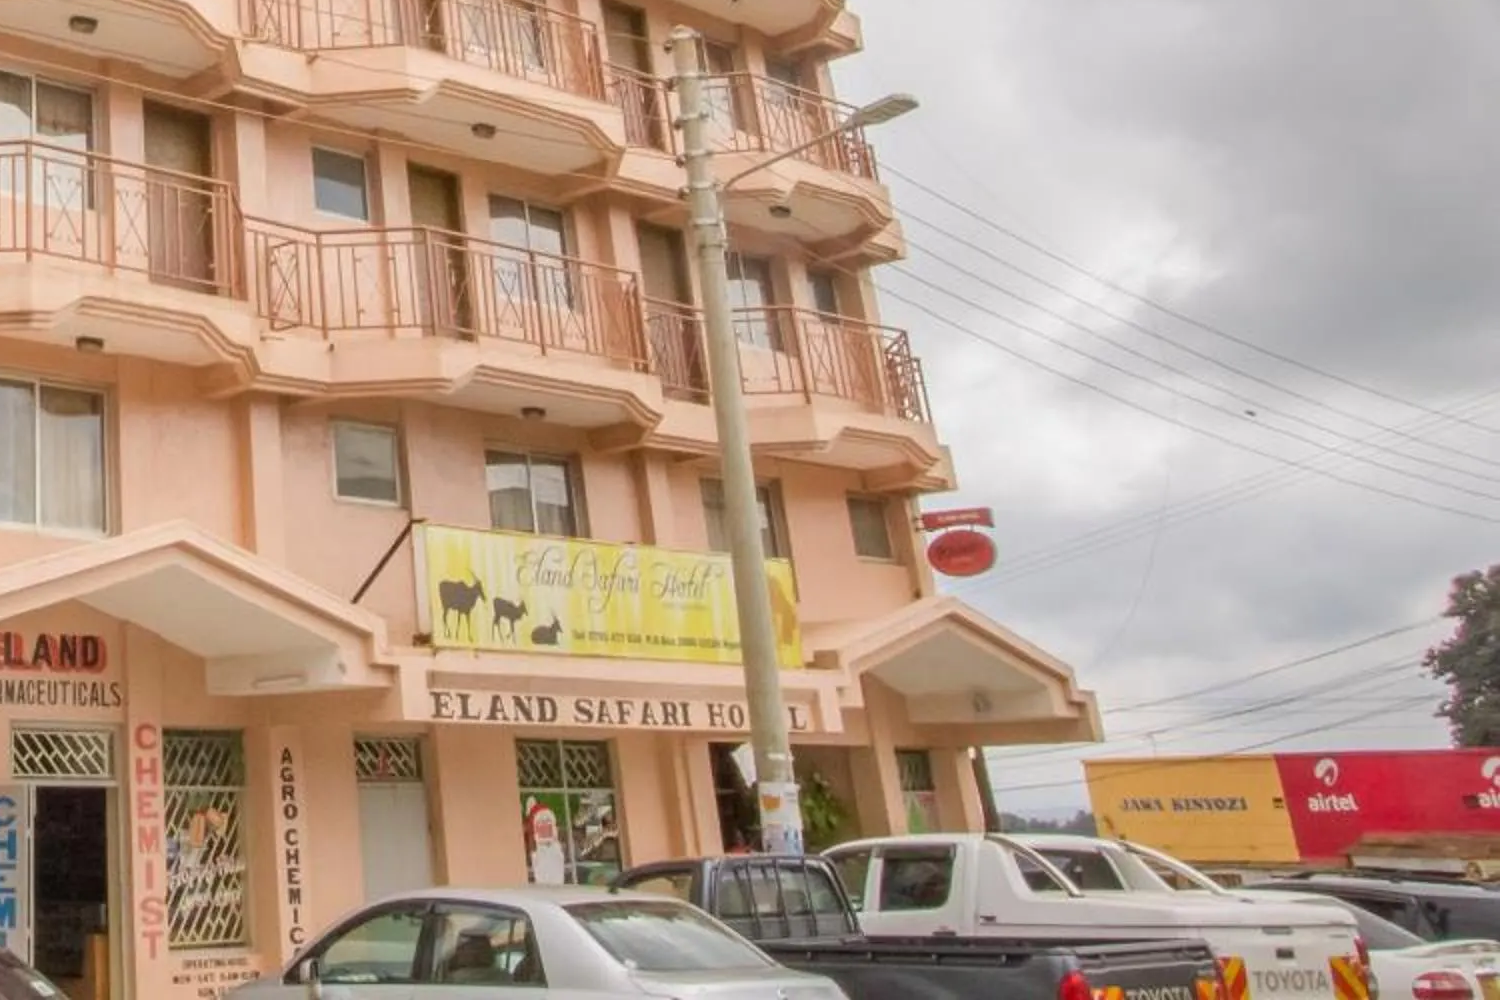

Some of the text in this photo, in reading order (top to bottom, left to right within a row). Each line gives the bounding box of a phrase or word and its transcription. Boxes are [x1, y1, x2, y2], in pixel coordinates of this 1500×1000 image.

[515, 546, 724, 614] Eland Safari Hotel
[430, 692, 807, 731] ELAND SAFARI HOL
[1307, 792, 1359, 812] airtel
[134, 724, 163, 960] CHEMIST
[280, 747, 304, 957] AGRO CHEMIC
[1252, 969, 1329, 992] TOYOTA
